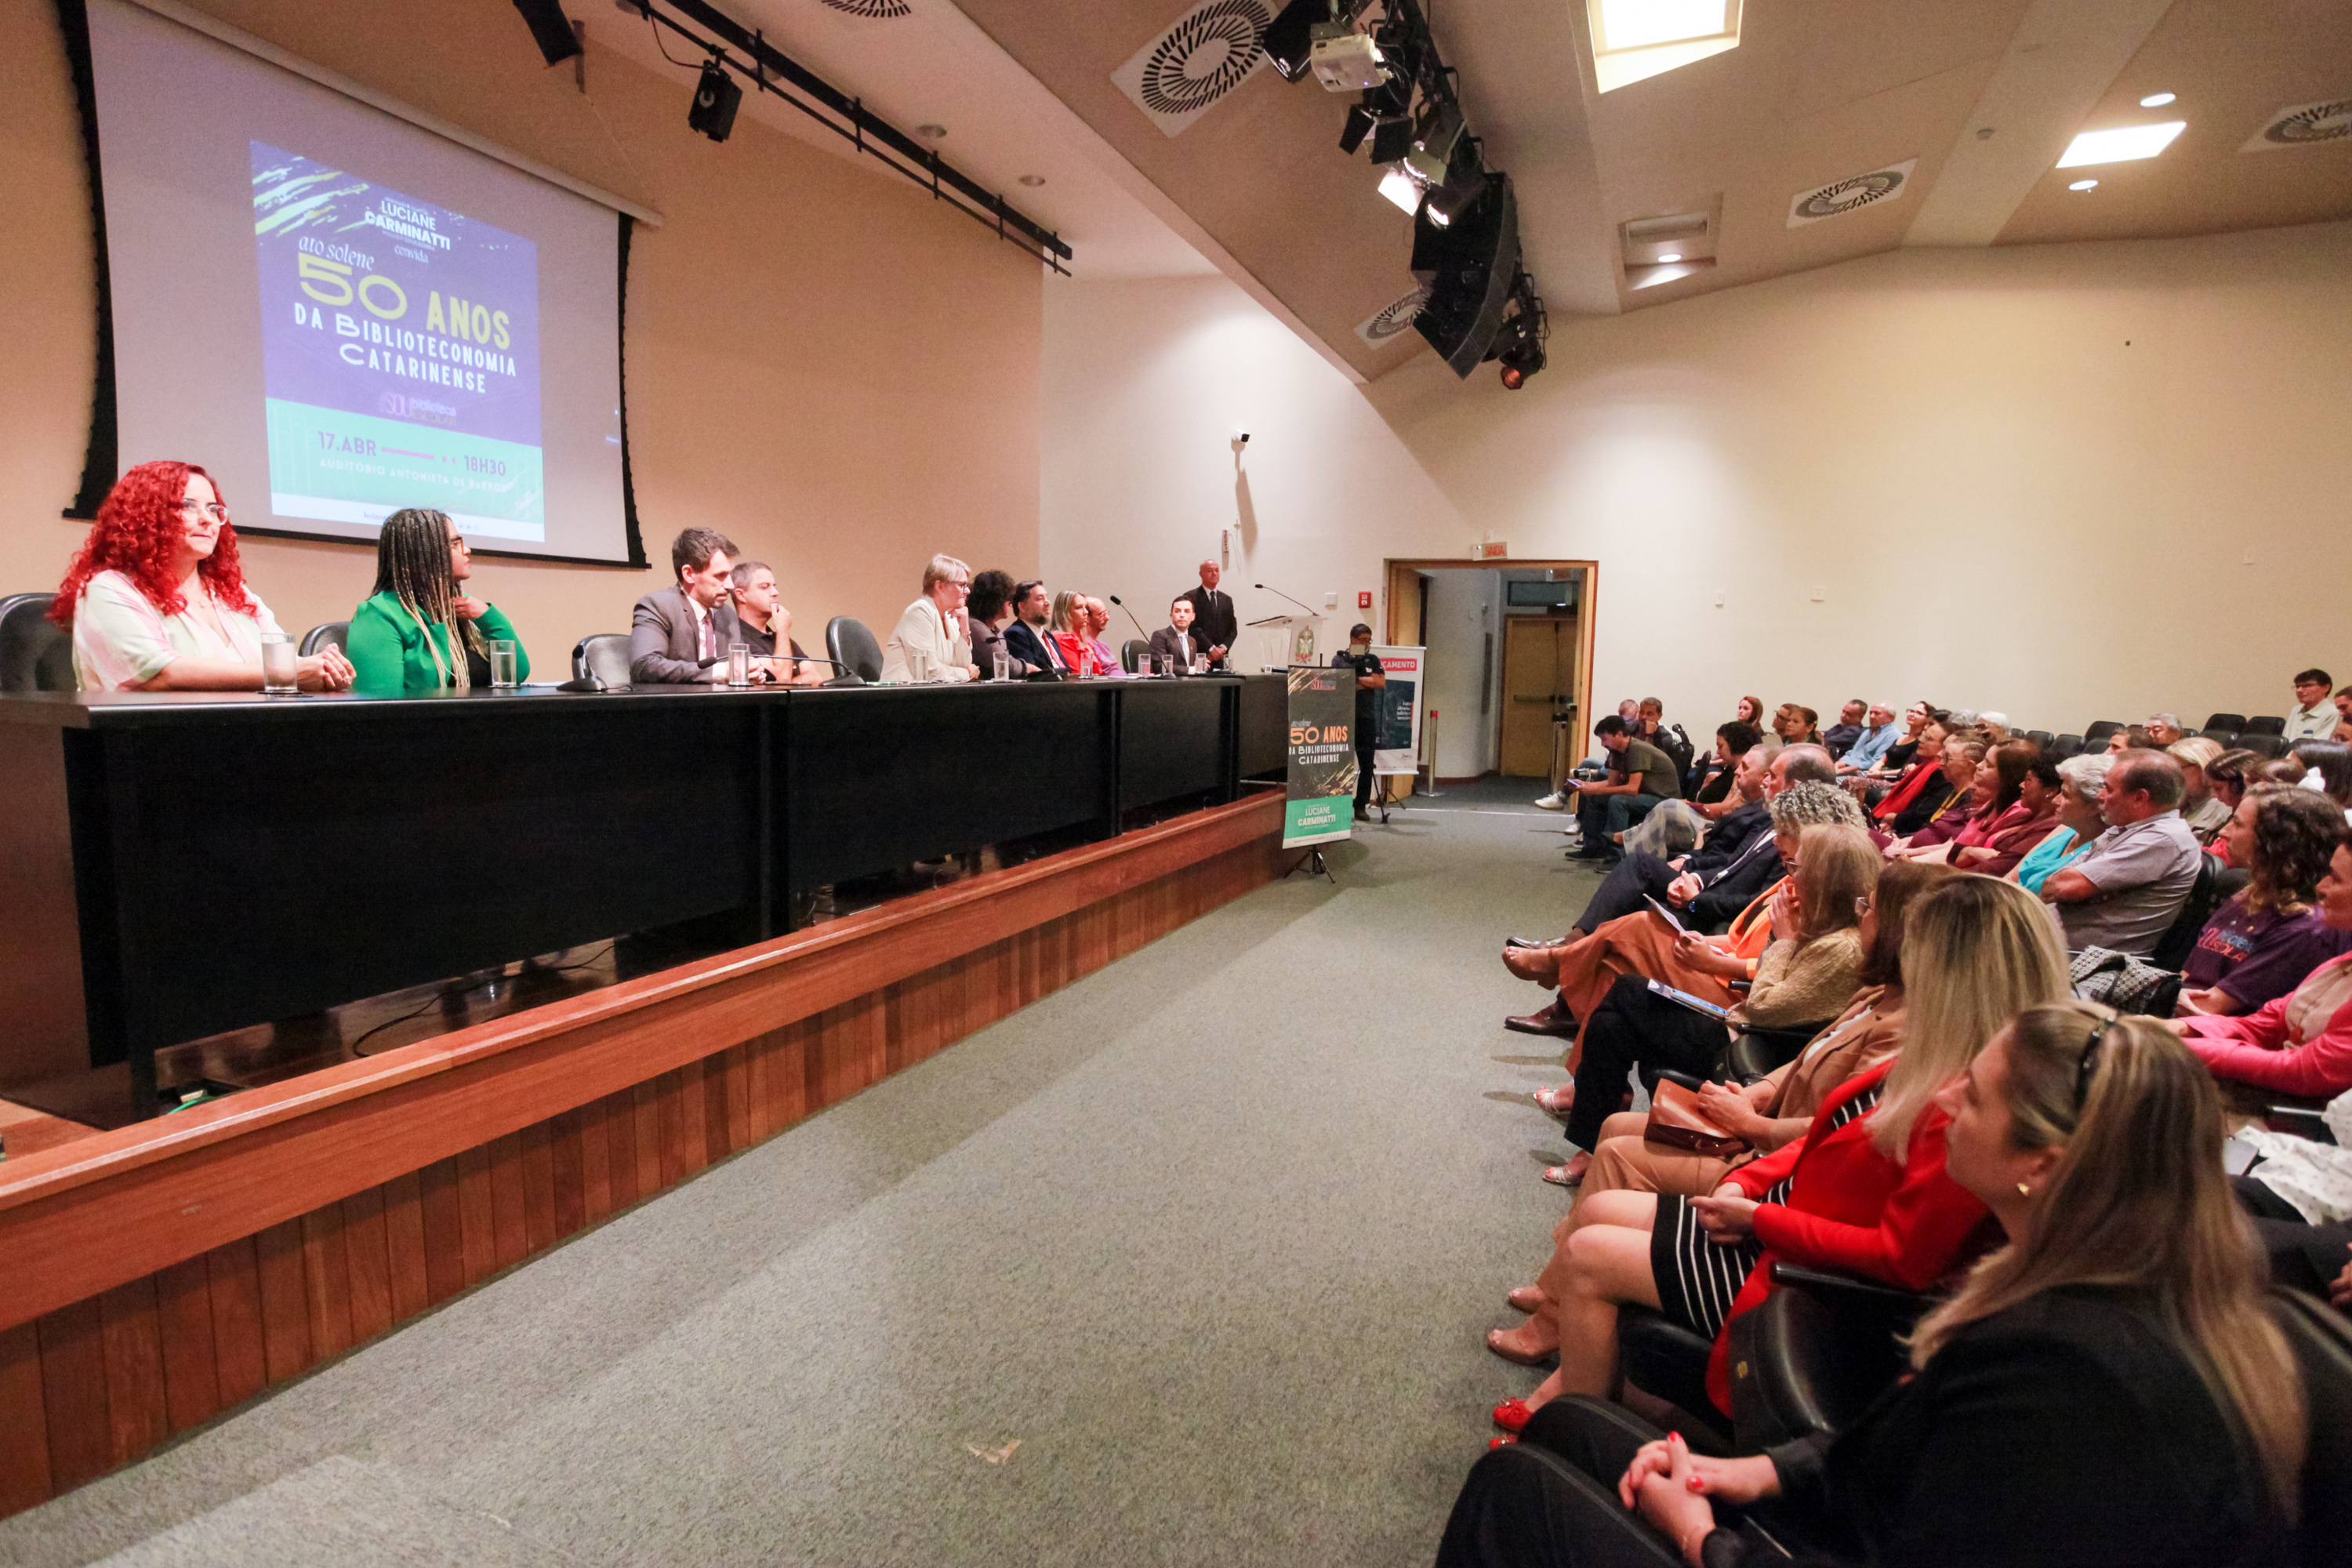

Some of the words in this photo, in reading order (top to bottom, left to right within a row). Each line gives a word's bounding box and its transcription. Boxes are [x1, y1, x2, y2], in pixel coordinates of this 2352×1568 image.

[381, 200, 436, 231] LUCIANE
[365, 210, 451, 250] CARMINATTI
[326, 244, 375, 270] solene
[299, 252, 408, 320] 50
[426, 291, 510, 350] ANOS
[295, 302, 323, 330] DA
[336, 312, 517, 377] BIBLIOTECONOMIA
[339, 343, 486, 394] CATARINENSE
[318, 431, 377, 456] 17.ABR
[464, 456, 506, 476] 18H30
[390, 468, 449, 485] ANTONIETA
[453, 477, 466, 487] DE
[1290, 727, 1319, 745] 50
[1323, 725, 1348, 743] ANOS
[1298, 743, 1349, 755] BIBLIOTECONOMIA
[1298, 753, 1340, 764] CATARINENSE
[1298, 815, 1336, 826] CARMINATTI
[1305, 806, 1330, 816] LUCIANE
